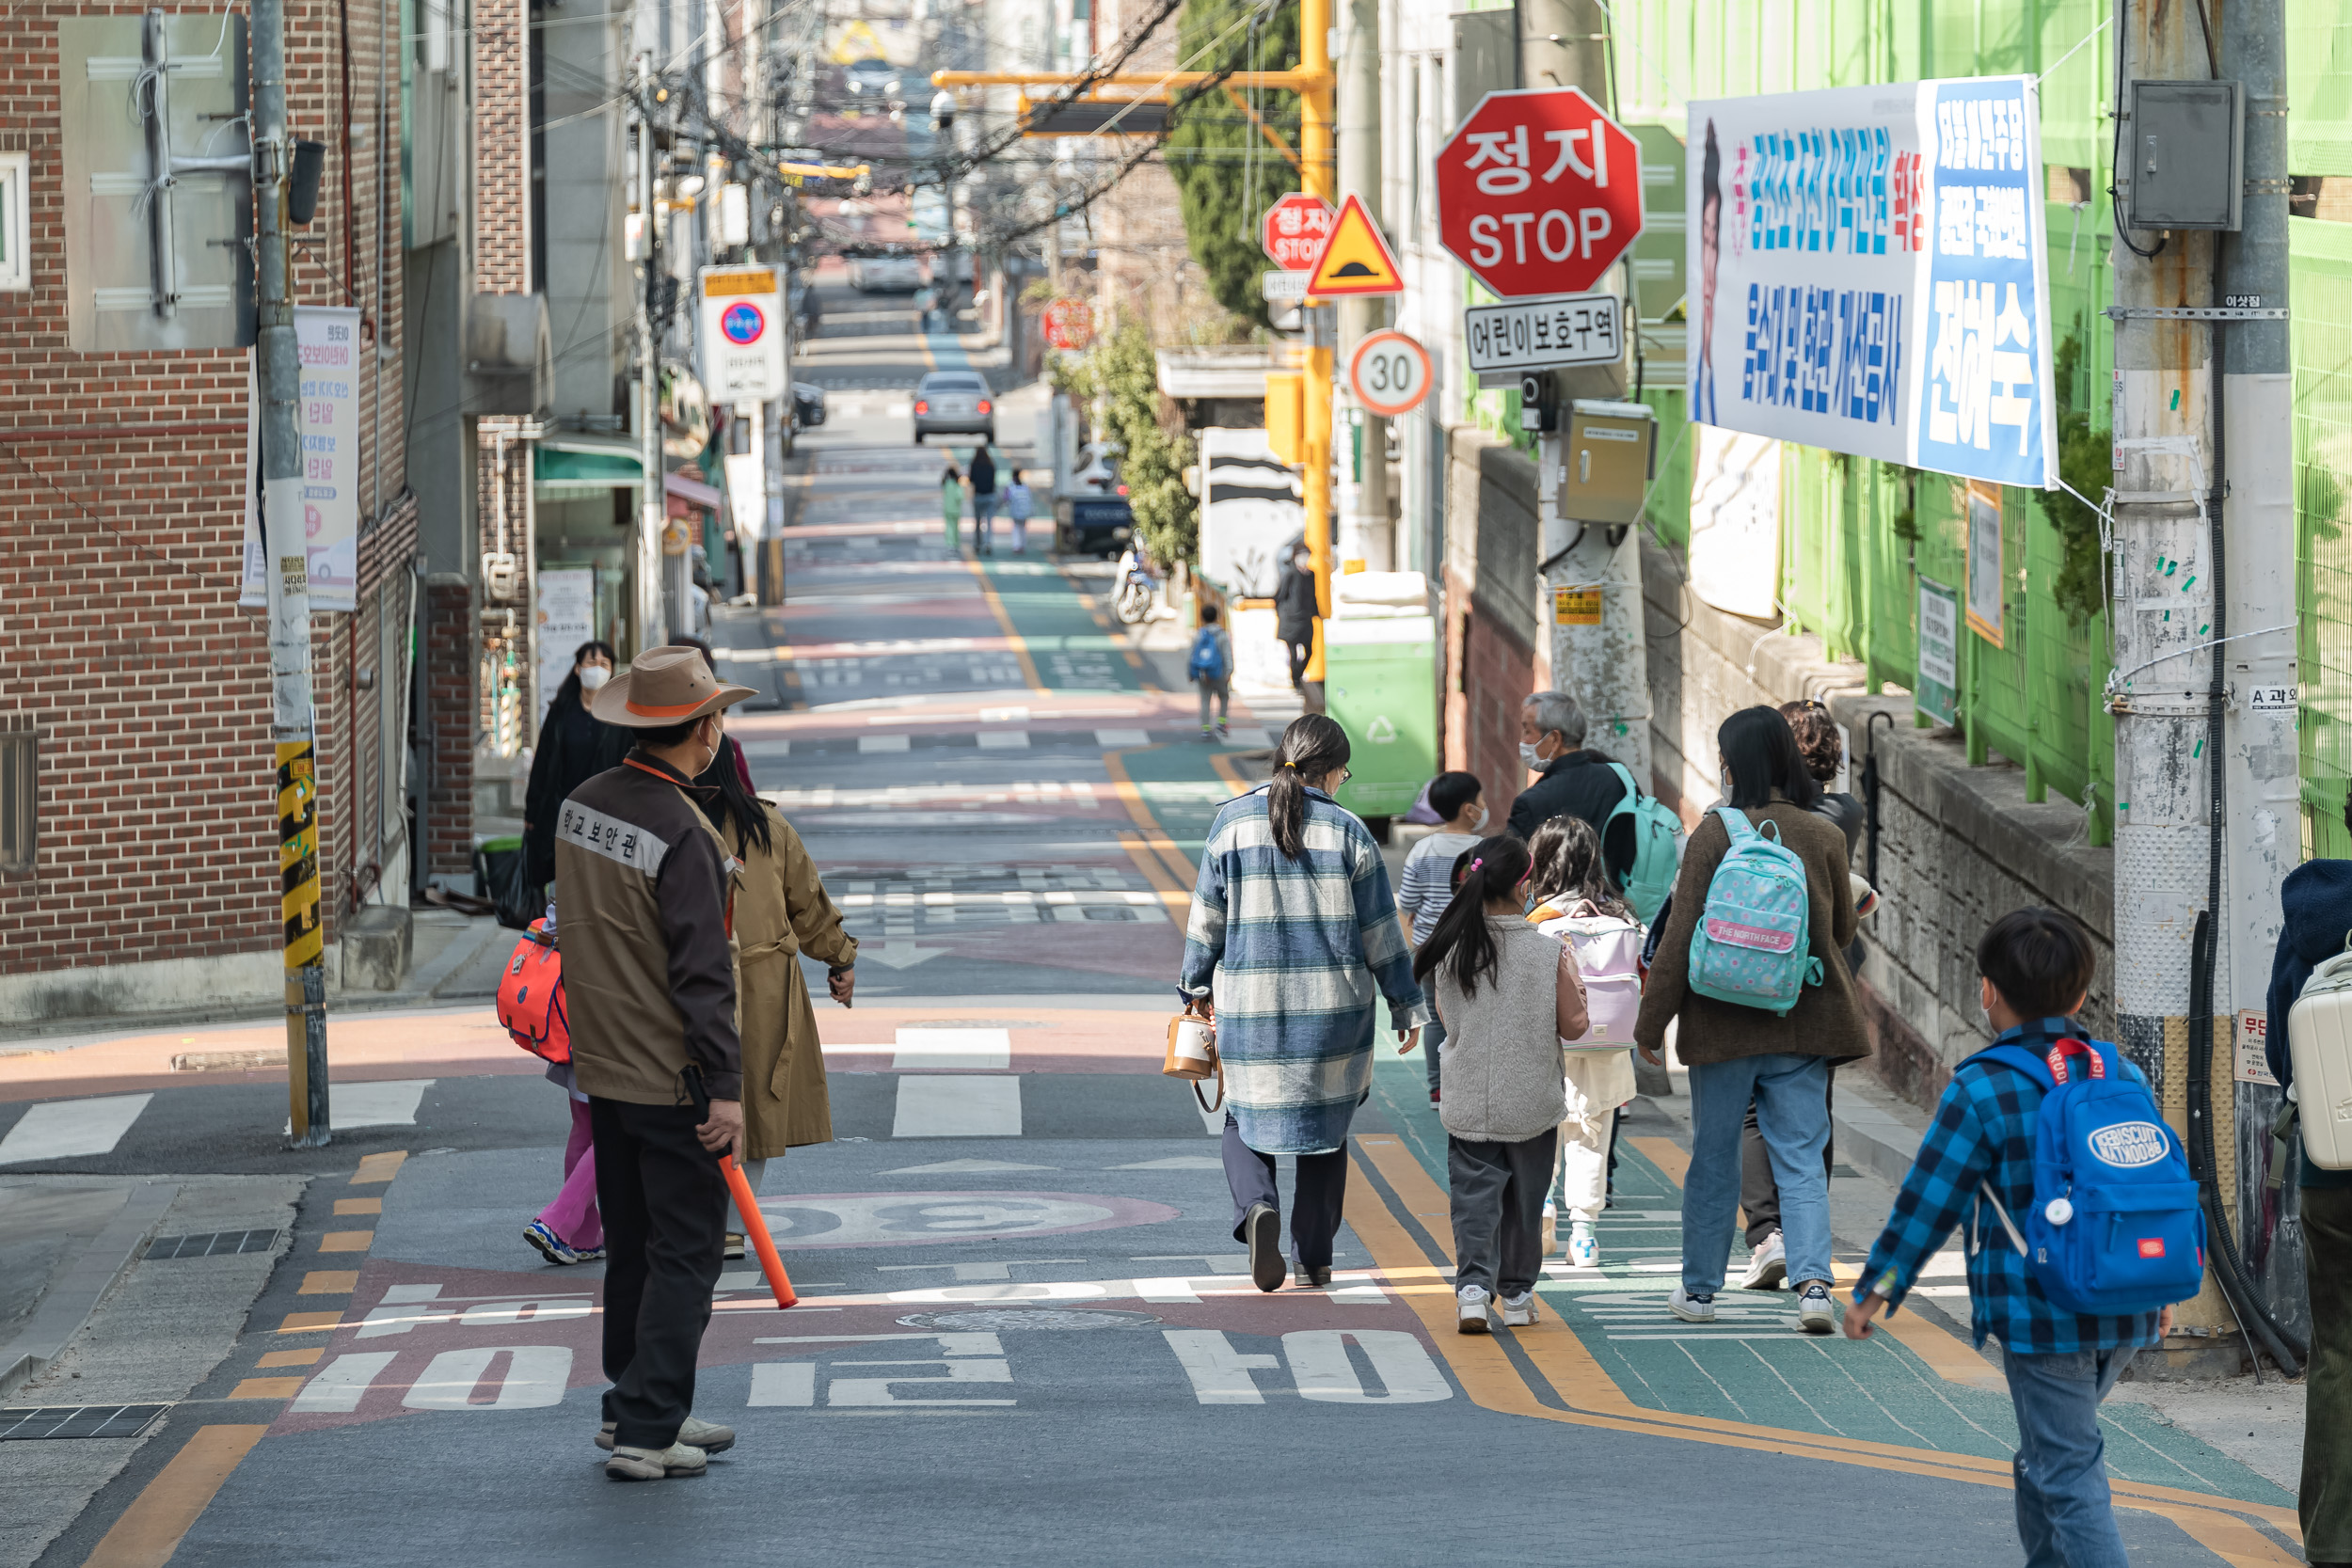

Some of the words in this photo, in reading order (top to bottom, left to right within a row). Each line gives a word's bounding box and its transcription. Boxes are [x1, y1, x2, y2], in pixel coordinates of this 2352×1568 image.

[1464, 119, 1610, 196] 정지
[1938, 98, 2024, 171] 더불어민주당
[1470, 207, 1613, 268] STOP
[2226, 295, 2261, 308] 이삿짐
[1471, 306, 1615, 358] 어린이보호구역
[1783, 286, 1804, 407] 및
[1834, 290, 1902, 426] 개선공사
[1370, 354, 1411, 392] 30
[1929, 278, 2034, 457] 전혜숙
[563, 809, 638, 859] 학교보안관
[1719, 926, 1733, 937] THE
[1733, 929, 1760, 942] NORTH
[1760, 935, 1781, 945] FACE
[2099, 1141, 2163, 1164] BROOKLYN
[289, 1328, 1454, 1411] 어린이
